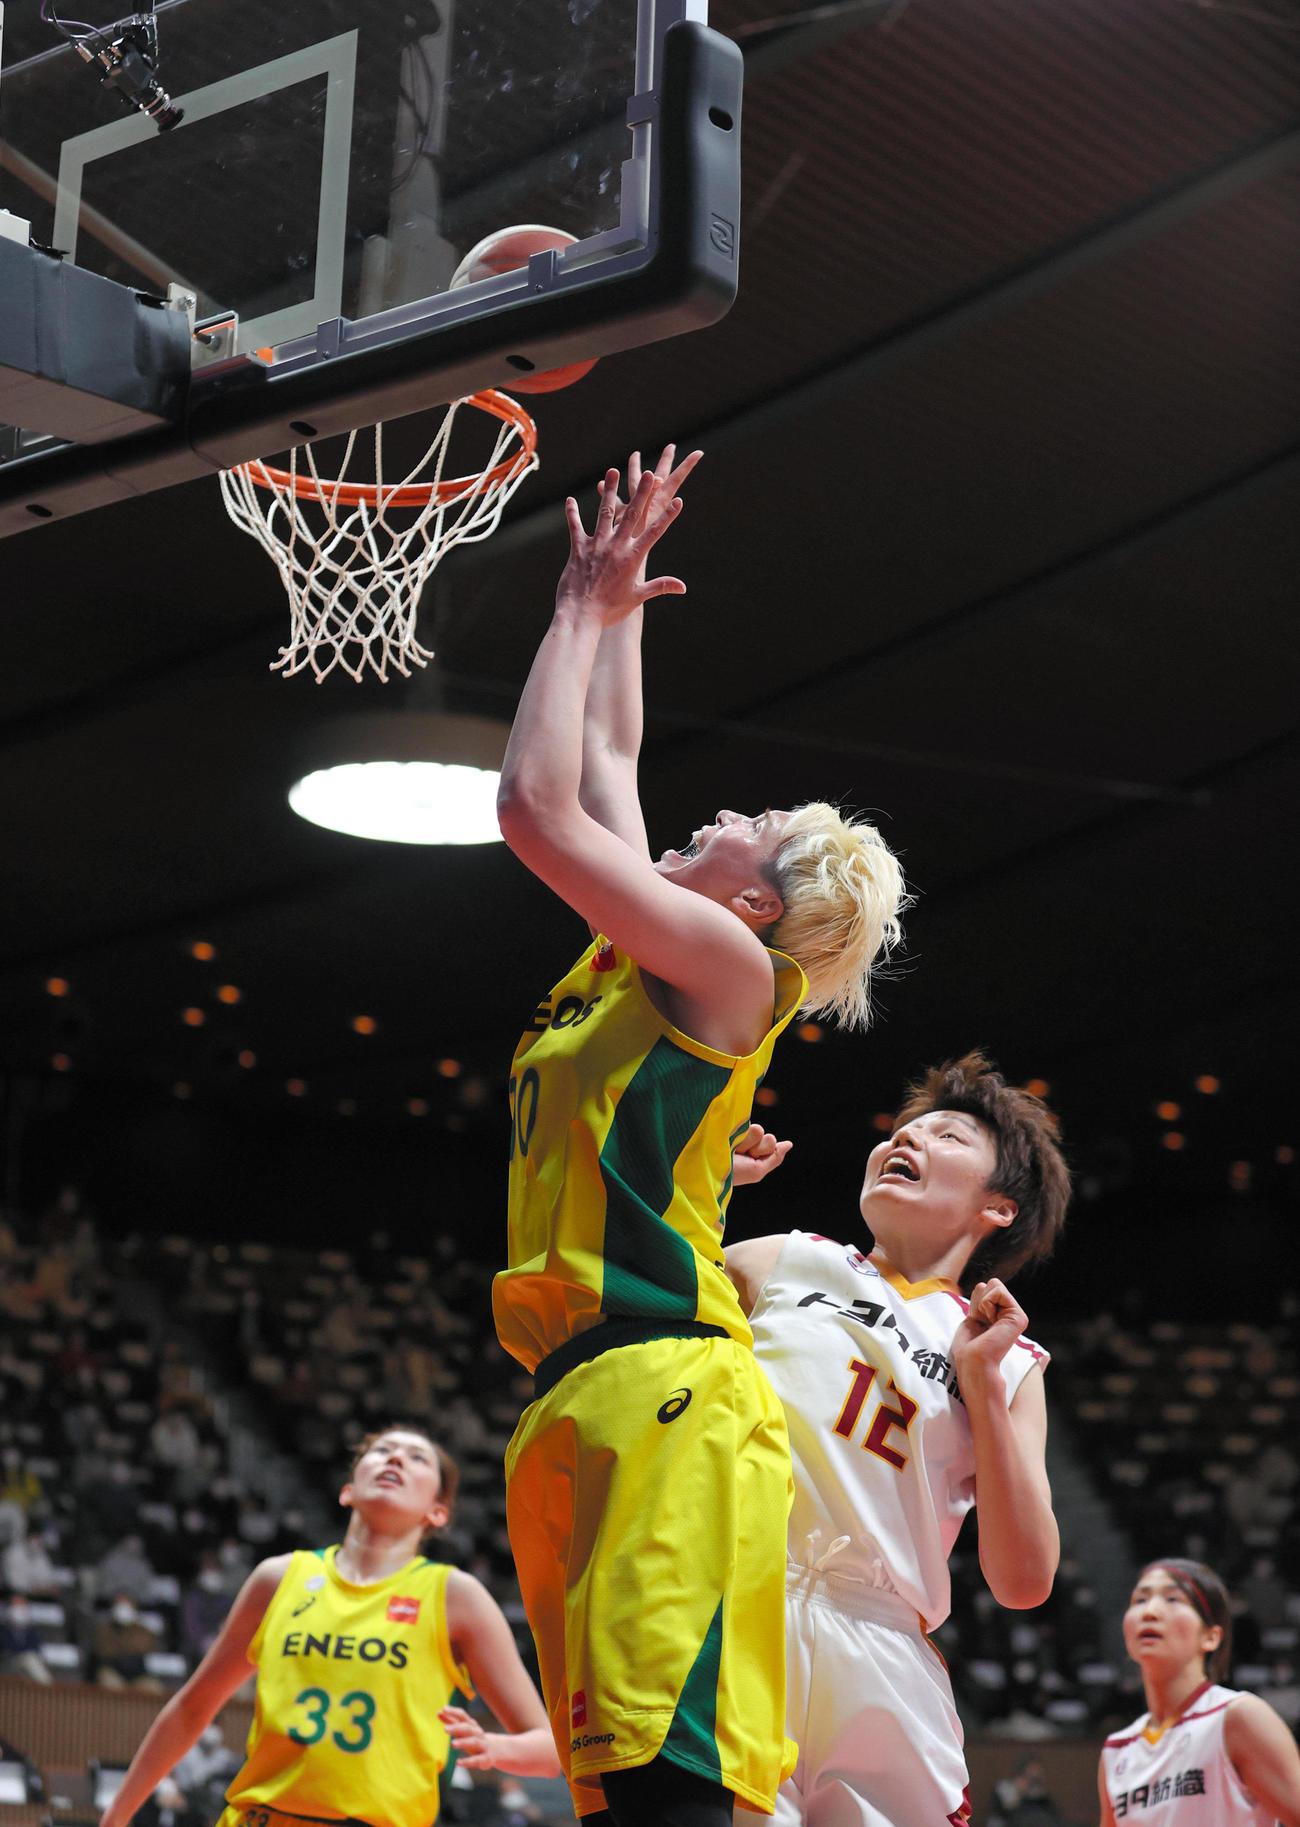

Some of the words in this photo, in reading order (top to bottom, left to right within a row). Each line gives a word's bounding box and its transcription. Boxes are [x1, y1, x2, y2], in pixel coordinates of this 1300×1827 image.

[832, 1356, 920, 1473] 12
[282, 1632, 410, 1670] ENEOS
[287, 1687, 377, 1755] 33
[582, 1733, 615, 1748] Group
[1112, 1769, 1206, 1819] ヨタ紡織
